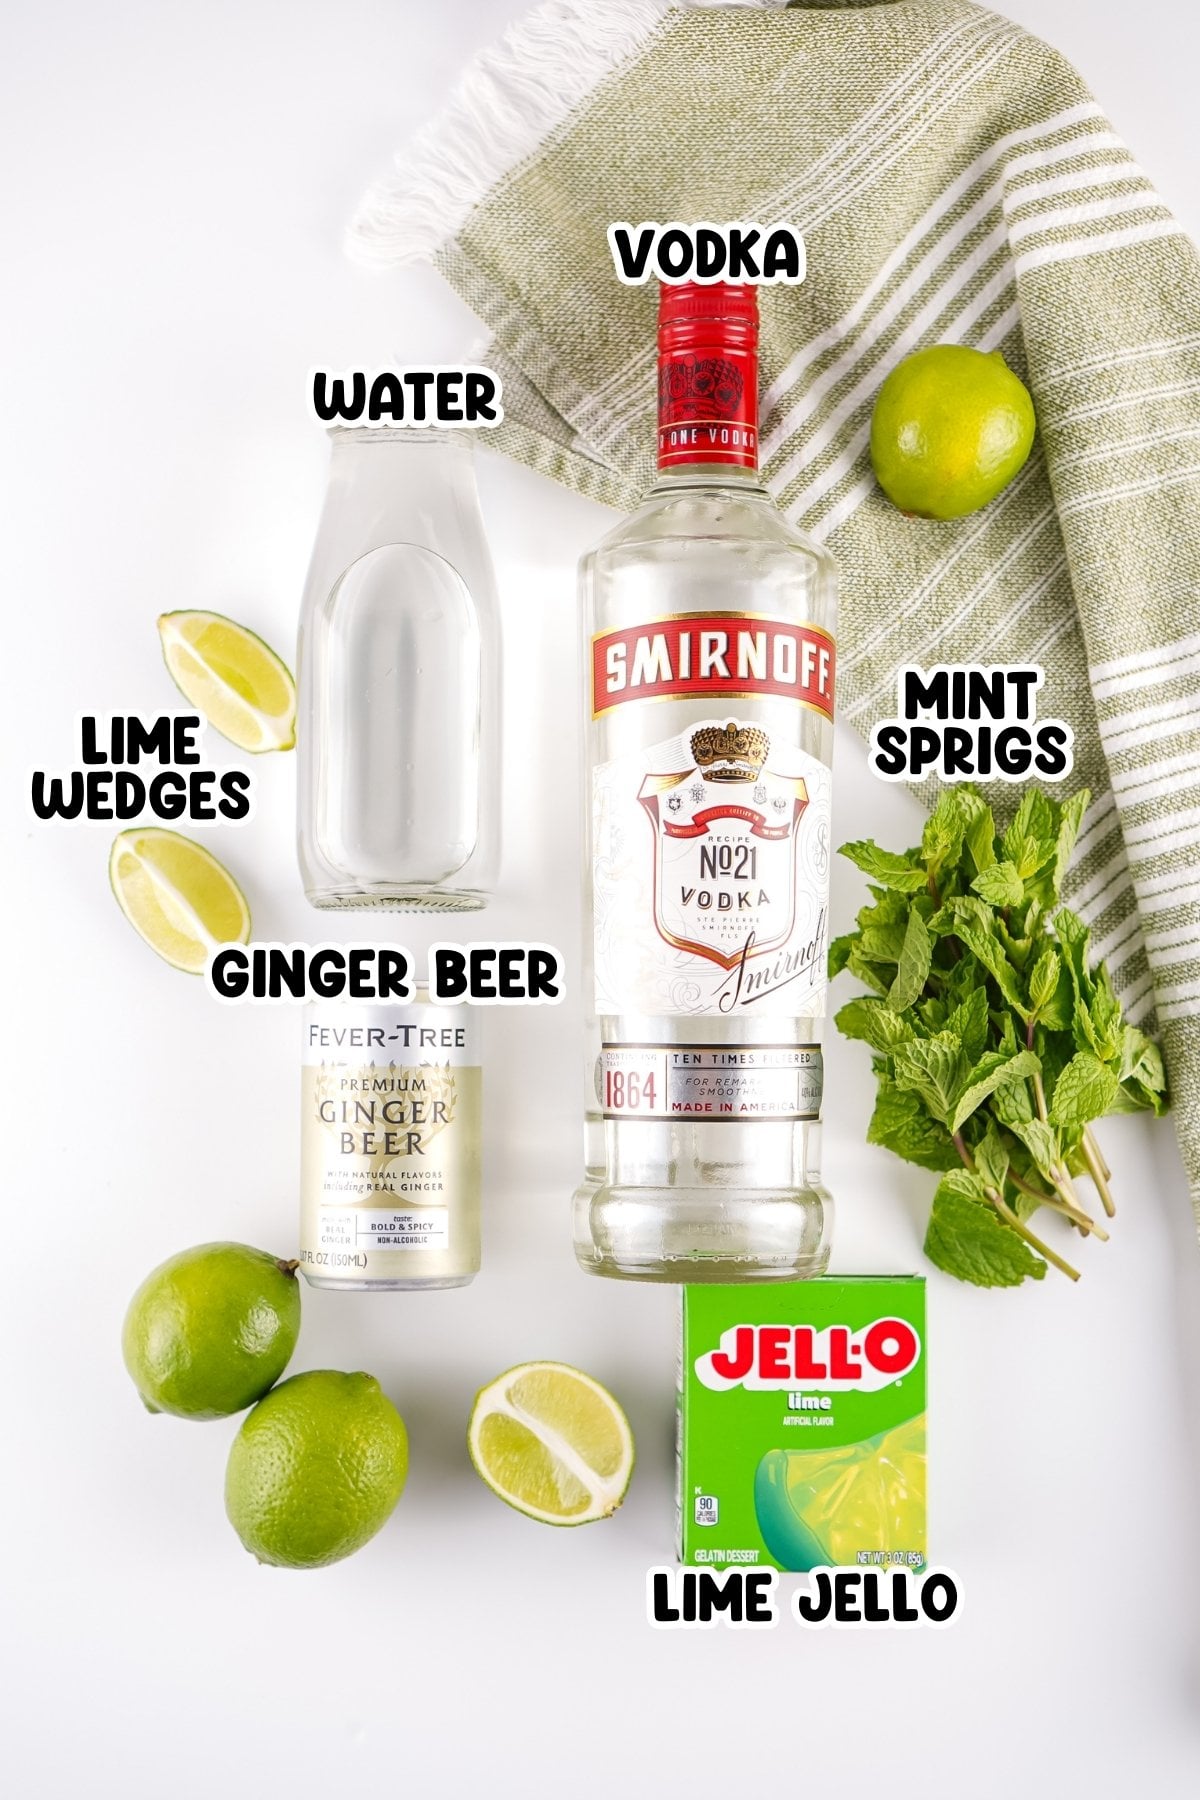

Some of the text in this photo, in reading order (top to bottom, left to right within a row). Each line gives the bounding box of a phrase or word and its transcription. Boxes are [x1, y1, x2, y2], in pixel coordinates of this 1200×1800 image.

[671, 428, 697, 446] ONE
[709, 428, 754, 448] VODKA
[606, 630, 830, 694] SMIRNOFF
[681, 886, 771, 911] VODKA
[673, 1054, 702, 1064] TEN
[712, 1054, 755, 1064] TIMES
[341, 1078, 426, 1091] PREMIUM
[685, 1077, 707, 1086] FOR
[606, 1070, 657, 1110] 1864
[320, 1100, 450, 1124] GINGER
[672, 1103, 796, 1112] MADE IN AMERICA
[340, 1132, 426, 1155] BEER
[366, 1183, 396, 1191] REAL
[400, 1183, 444, 1191] GINGER
[398, 1223, 405, 1231] &
[316, 1252, 329, 1265] OZ
[331, 1253, 368, 1269] (150ML)
[788, 1393, 832, 1411] lime
[783, 1416, 834, 1426] ARTIFICIAL FLAVOR
[700, 1498, 713, 1510] 90
[695, 1550, 760, 1562] GELATIN DESSERT
[857, 1551, 924, 1567] NET WT 3 OZ (85g)
